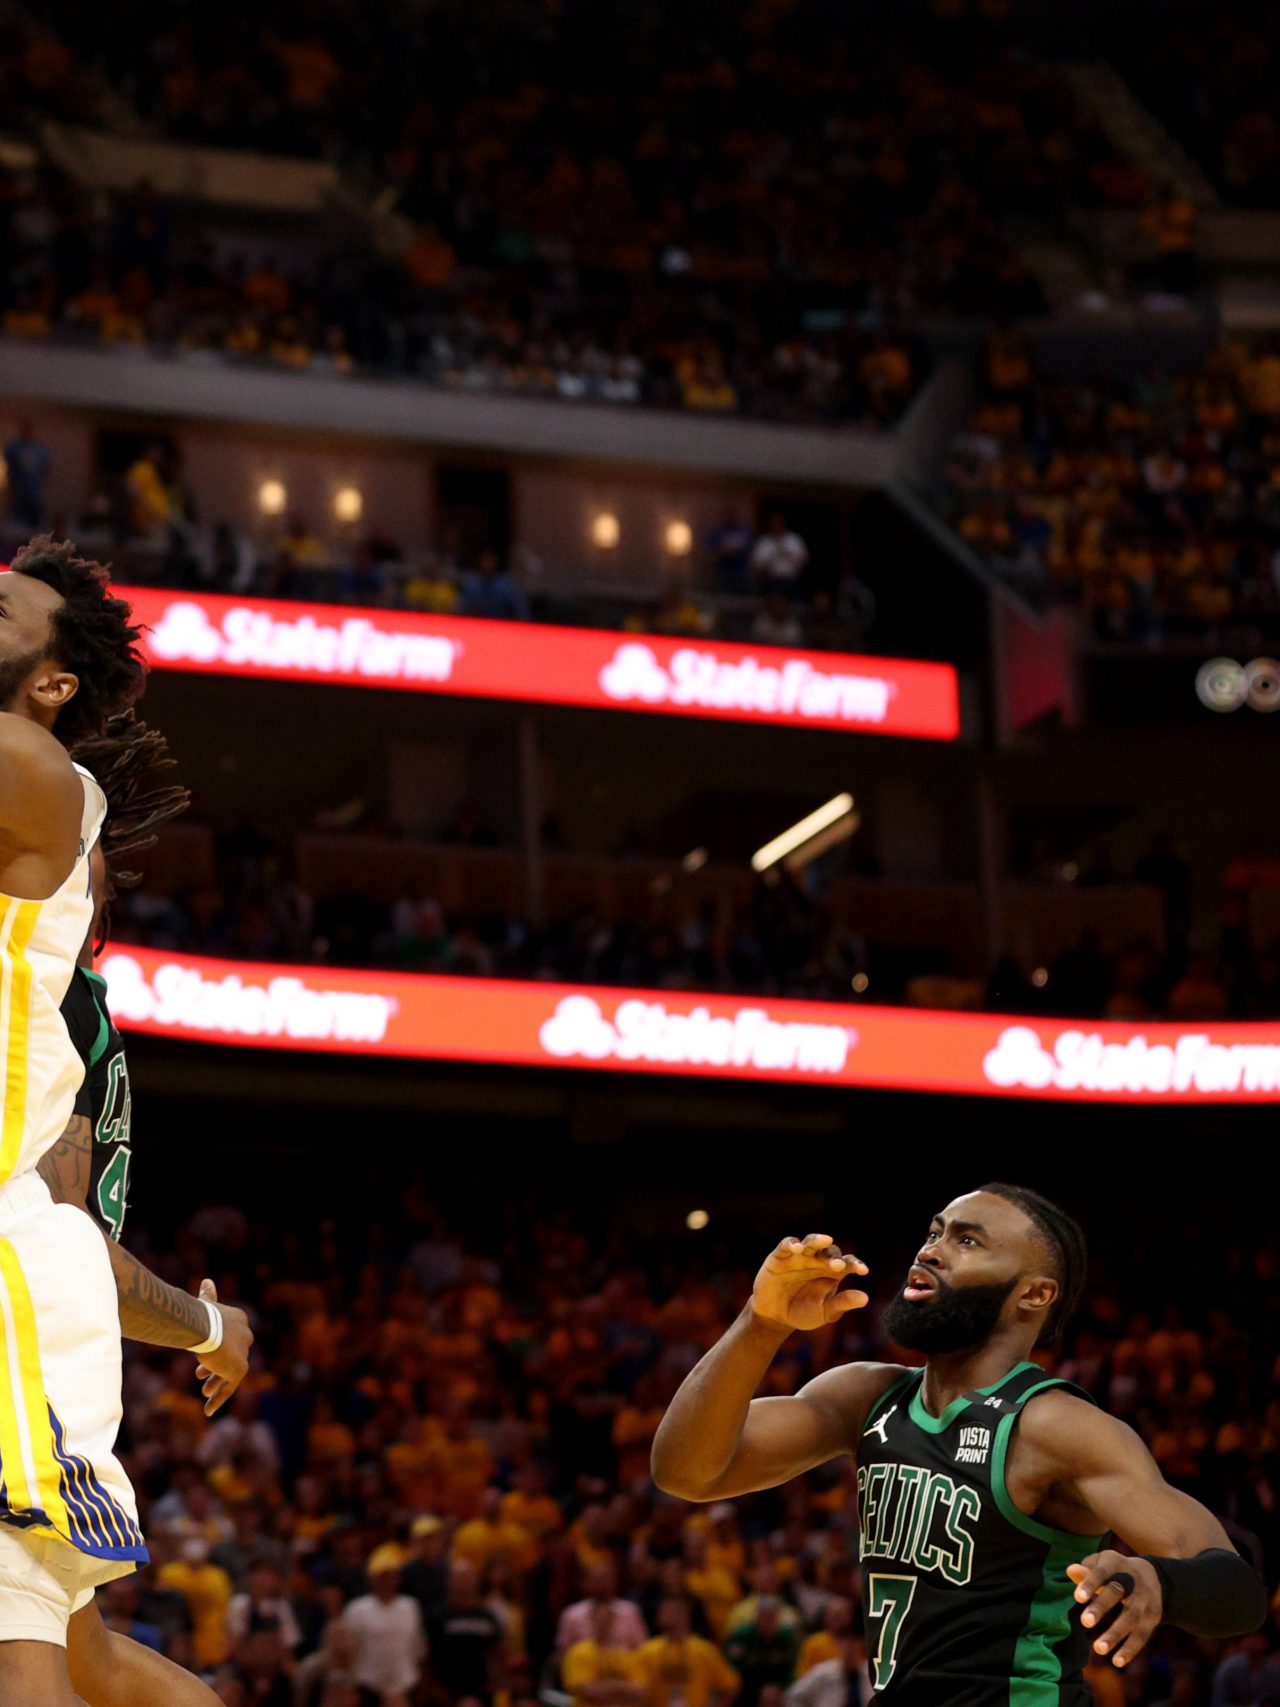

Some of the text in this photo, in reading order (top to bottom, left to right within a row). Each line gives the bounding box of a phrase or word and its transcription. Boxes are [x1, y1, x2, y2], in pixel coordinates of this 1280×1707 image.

[97, 1144, 132, 1244] 4
[955, 1448, 988, 1464] PRINT
[960, 1427, 990, 1449] VISTA
[857, 1463, 981, 1586] CELTICS
[869, 1573, 918, 1690] 7
